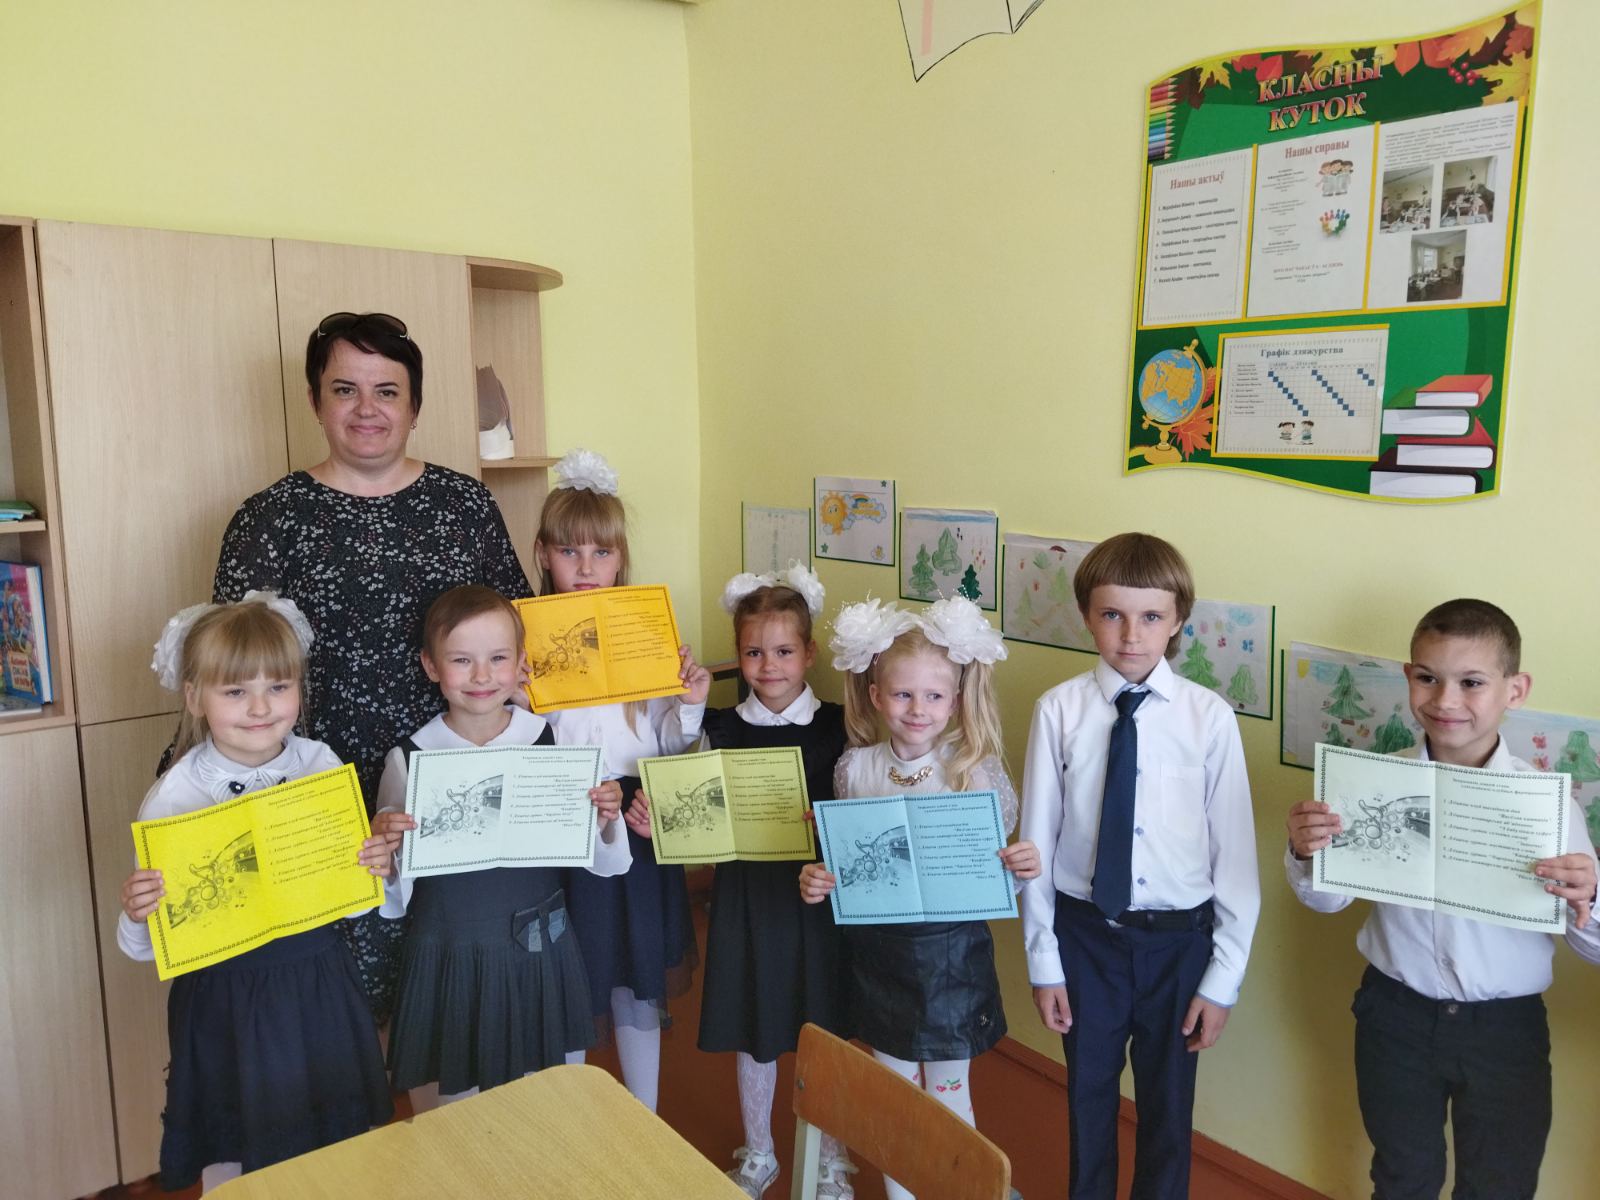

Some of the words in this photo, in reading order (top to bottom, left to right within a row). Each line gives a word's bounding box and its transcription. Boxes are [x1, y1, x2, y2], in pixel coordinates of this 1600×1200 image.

[1257, 55, 1384, 104] КЛАСНЫ
[1267, 91, 1368, 133] КУТОК
[1285, 146, 1312, 159] Нашы
[1315, 140, 1349, 155] справы
[1170, 178, 1196, 190] Нашы
[1261, 348, 1290, 358] Графік
